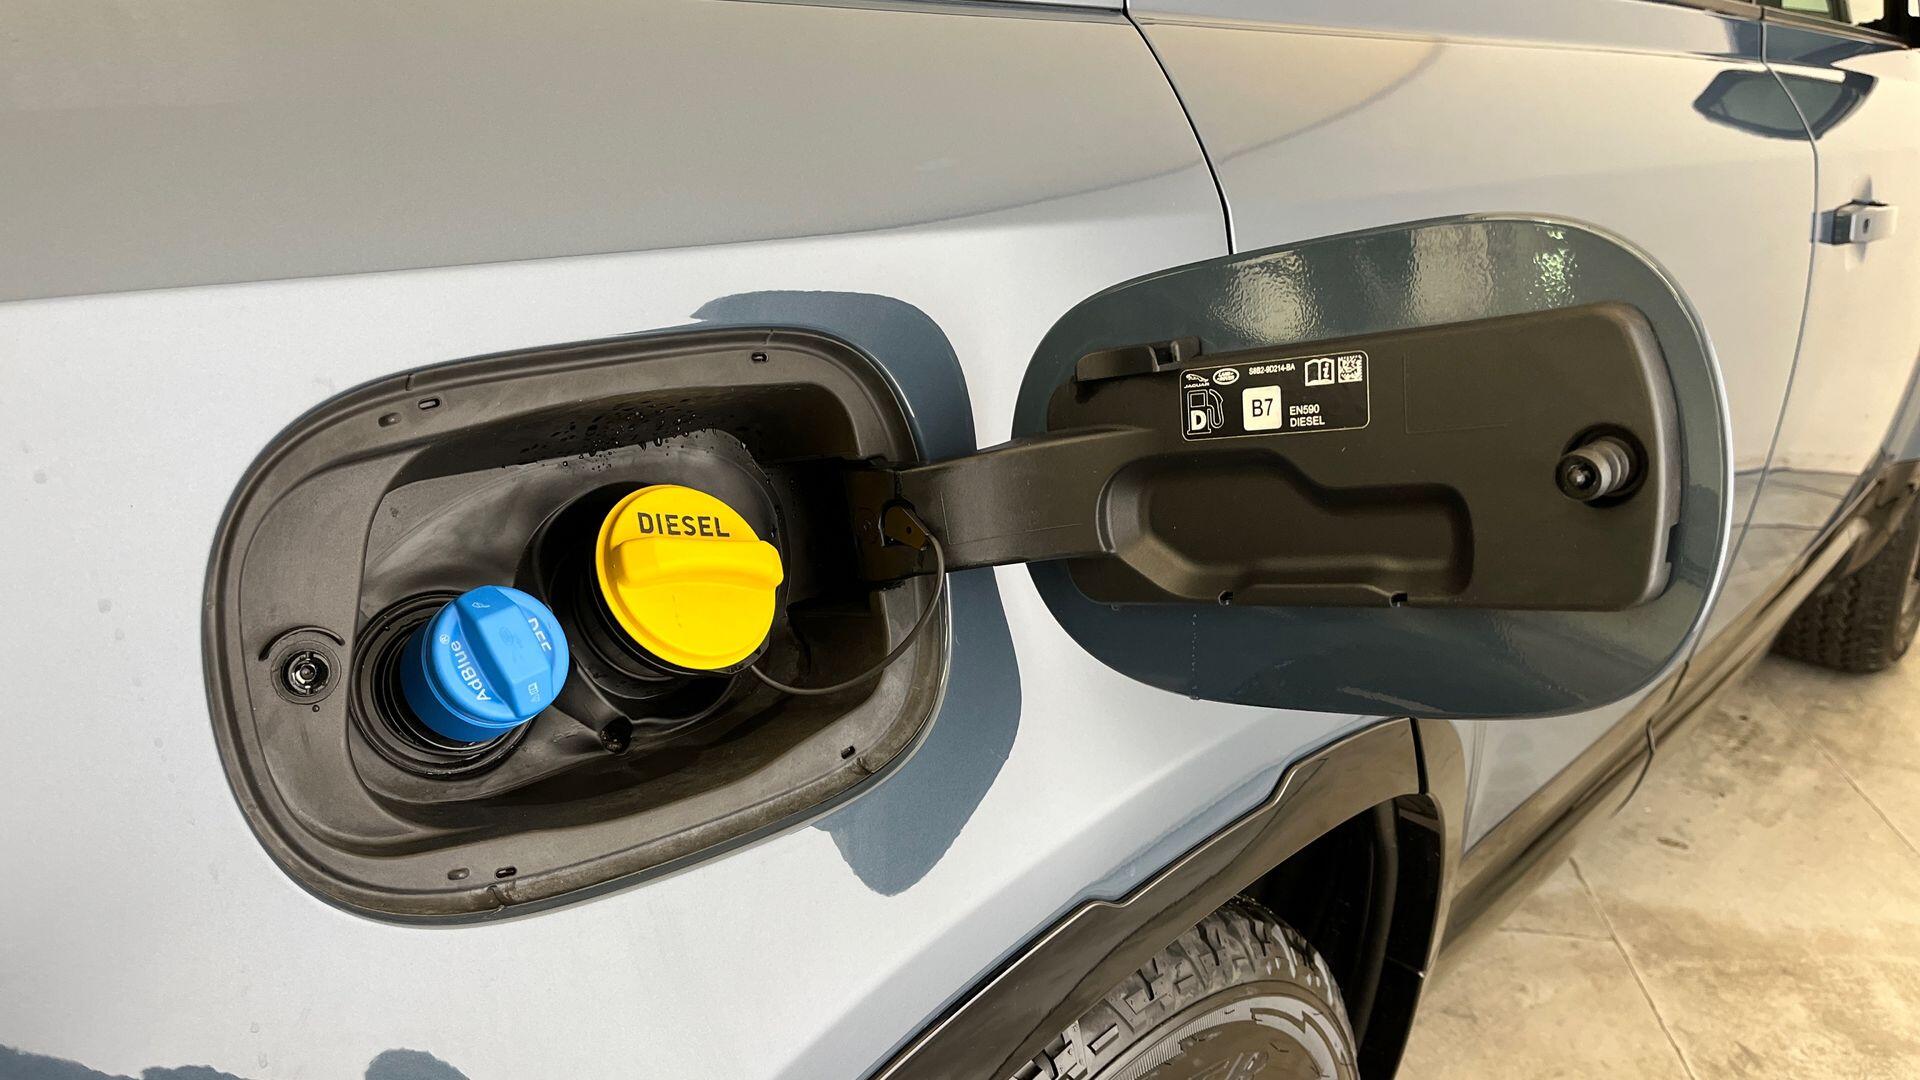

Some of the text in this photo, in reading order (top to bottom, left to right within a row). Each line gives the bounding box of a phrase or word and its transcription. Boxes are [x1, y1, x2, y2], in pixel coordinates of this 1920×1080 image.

[1252, 398, 1274, 418] B7
[1289, 404, 1320, 416] EN590
[1190, 409, 1207, 431] D
[1289, 414, 1325, 428] DIESEL
[637, 512, 731, 538] DIESEL
